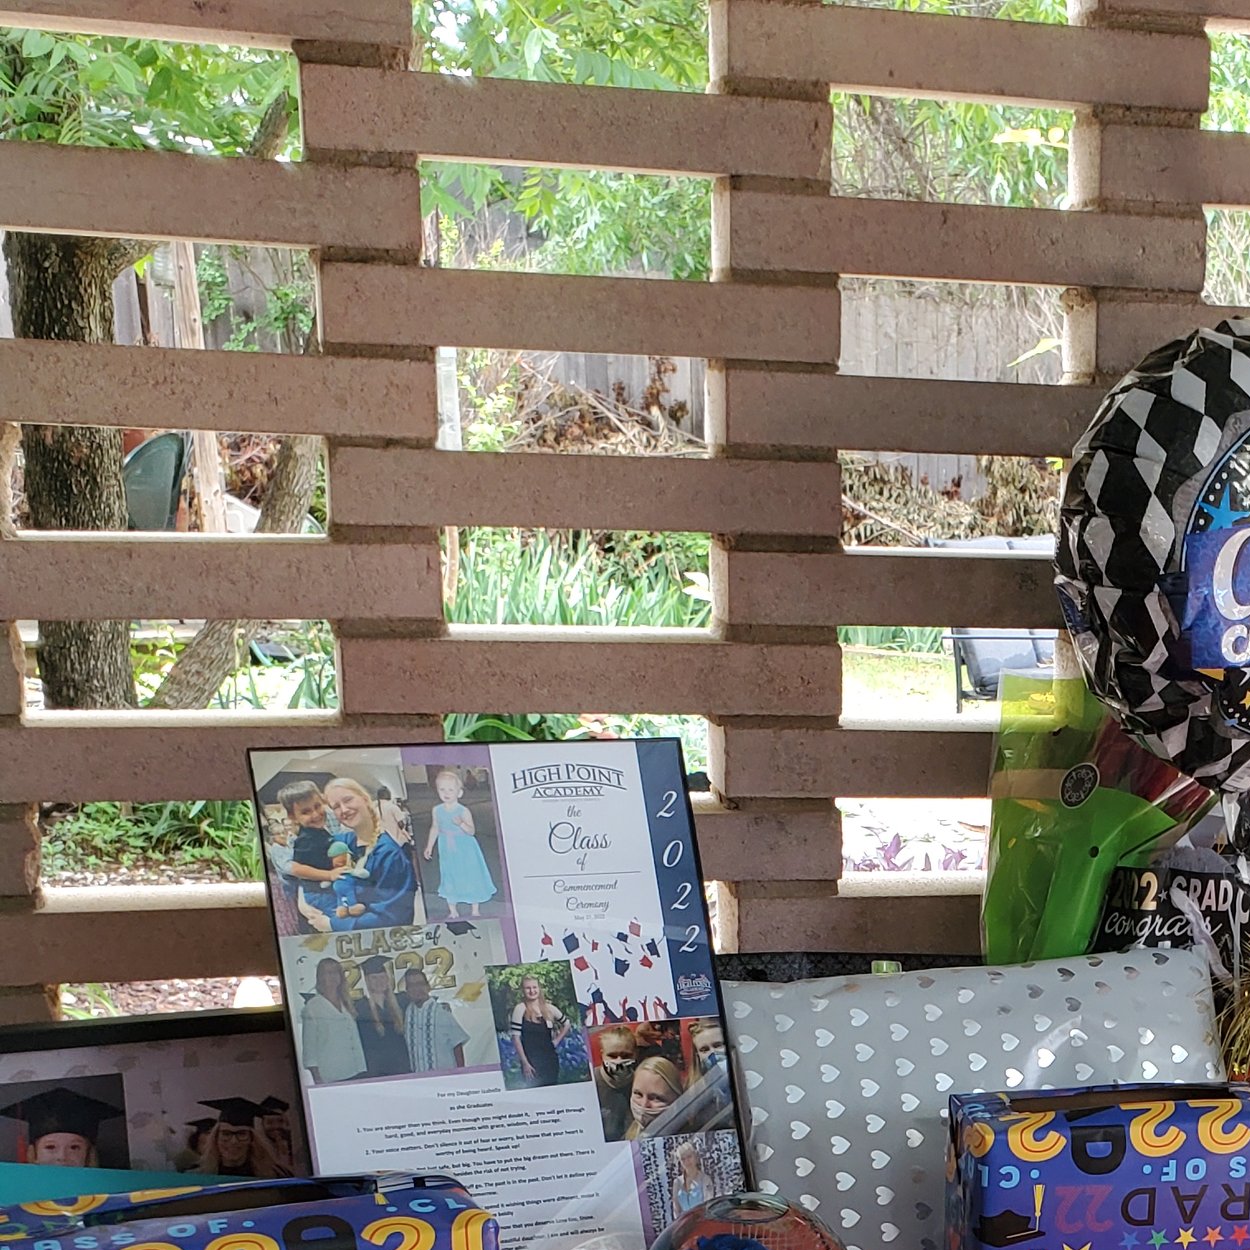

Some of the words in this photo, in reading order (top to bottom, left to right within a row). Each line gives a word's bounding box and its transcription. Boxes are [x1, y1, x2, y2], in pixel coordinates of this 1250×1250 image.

[511, 765, 560, 789] HIGH
[566, 763, 624, 786] POINT
[533, 786, 603, 797] ACADEMY
[567, 805, 581, 817] the
[549, 821, 612, 854] Class
[576, 853, 587, 870] of
[553, 880, 618, 894] Commencement
[1170, 875, 1233, 912] GRAD
[566, 897, 609, 912] Ceremony
[1105, 911, 1222, 947] congras
[335, 925, 424, 959] CLASS
[340, 947, 456, 999] 222
[1161, 1158, 1207, 1182] OF
[1055, 1185, 1115, 1234] 22
[167, 1219, 228, 1239] OF
